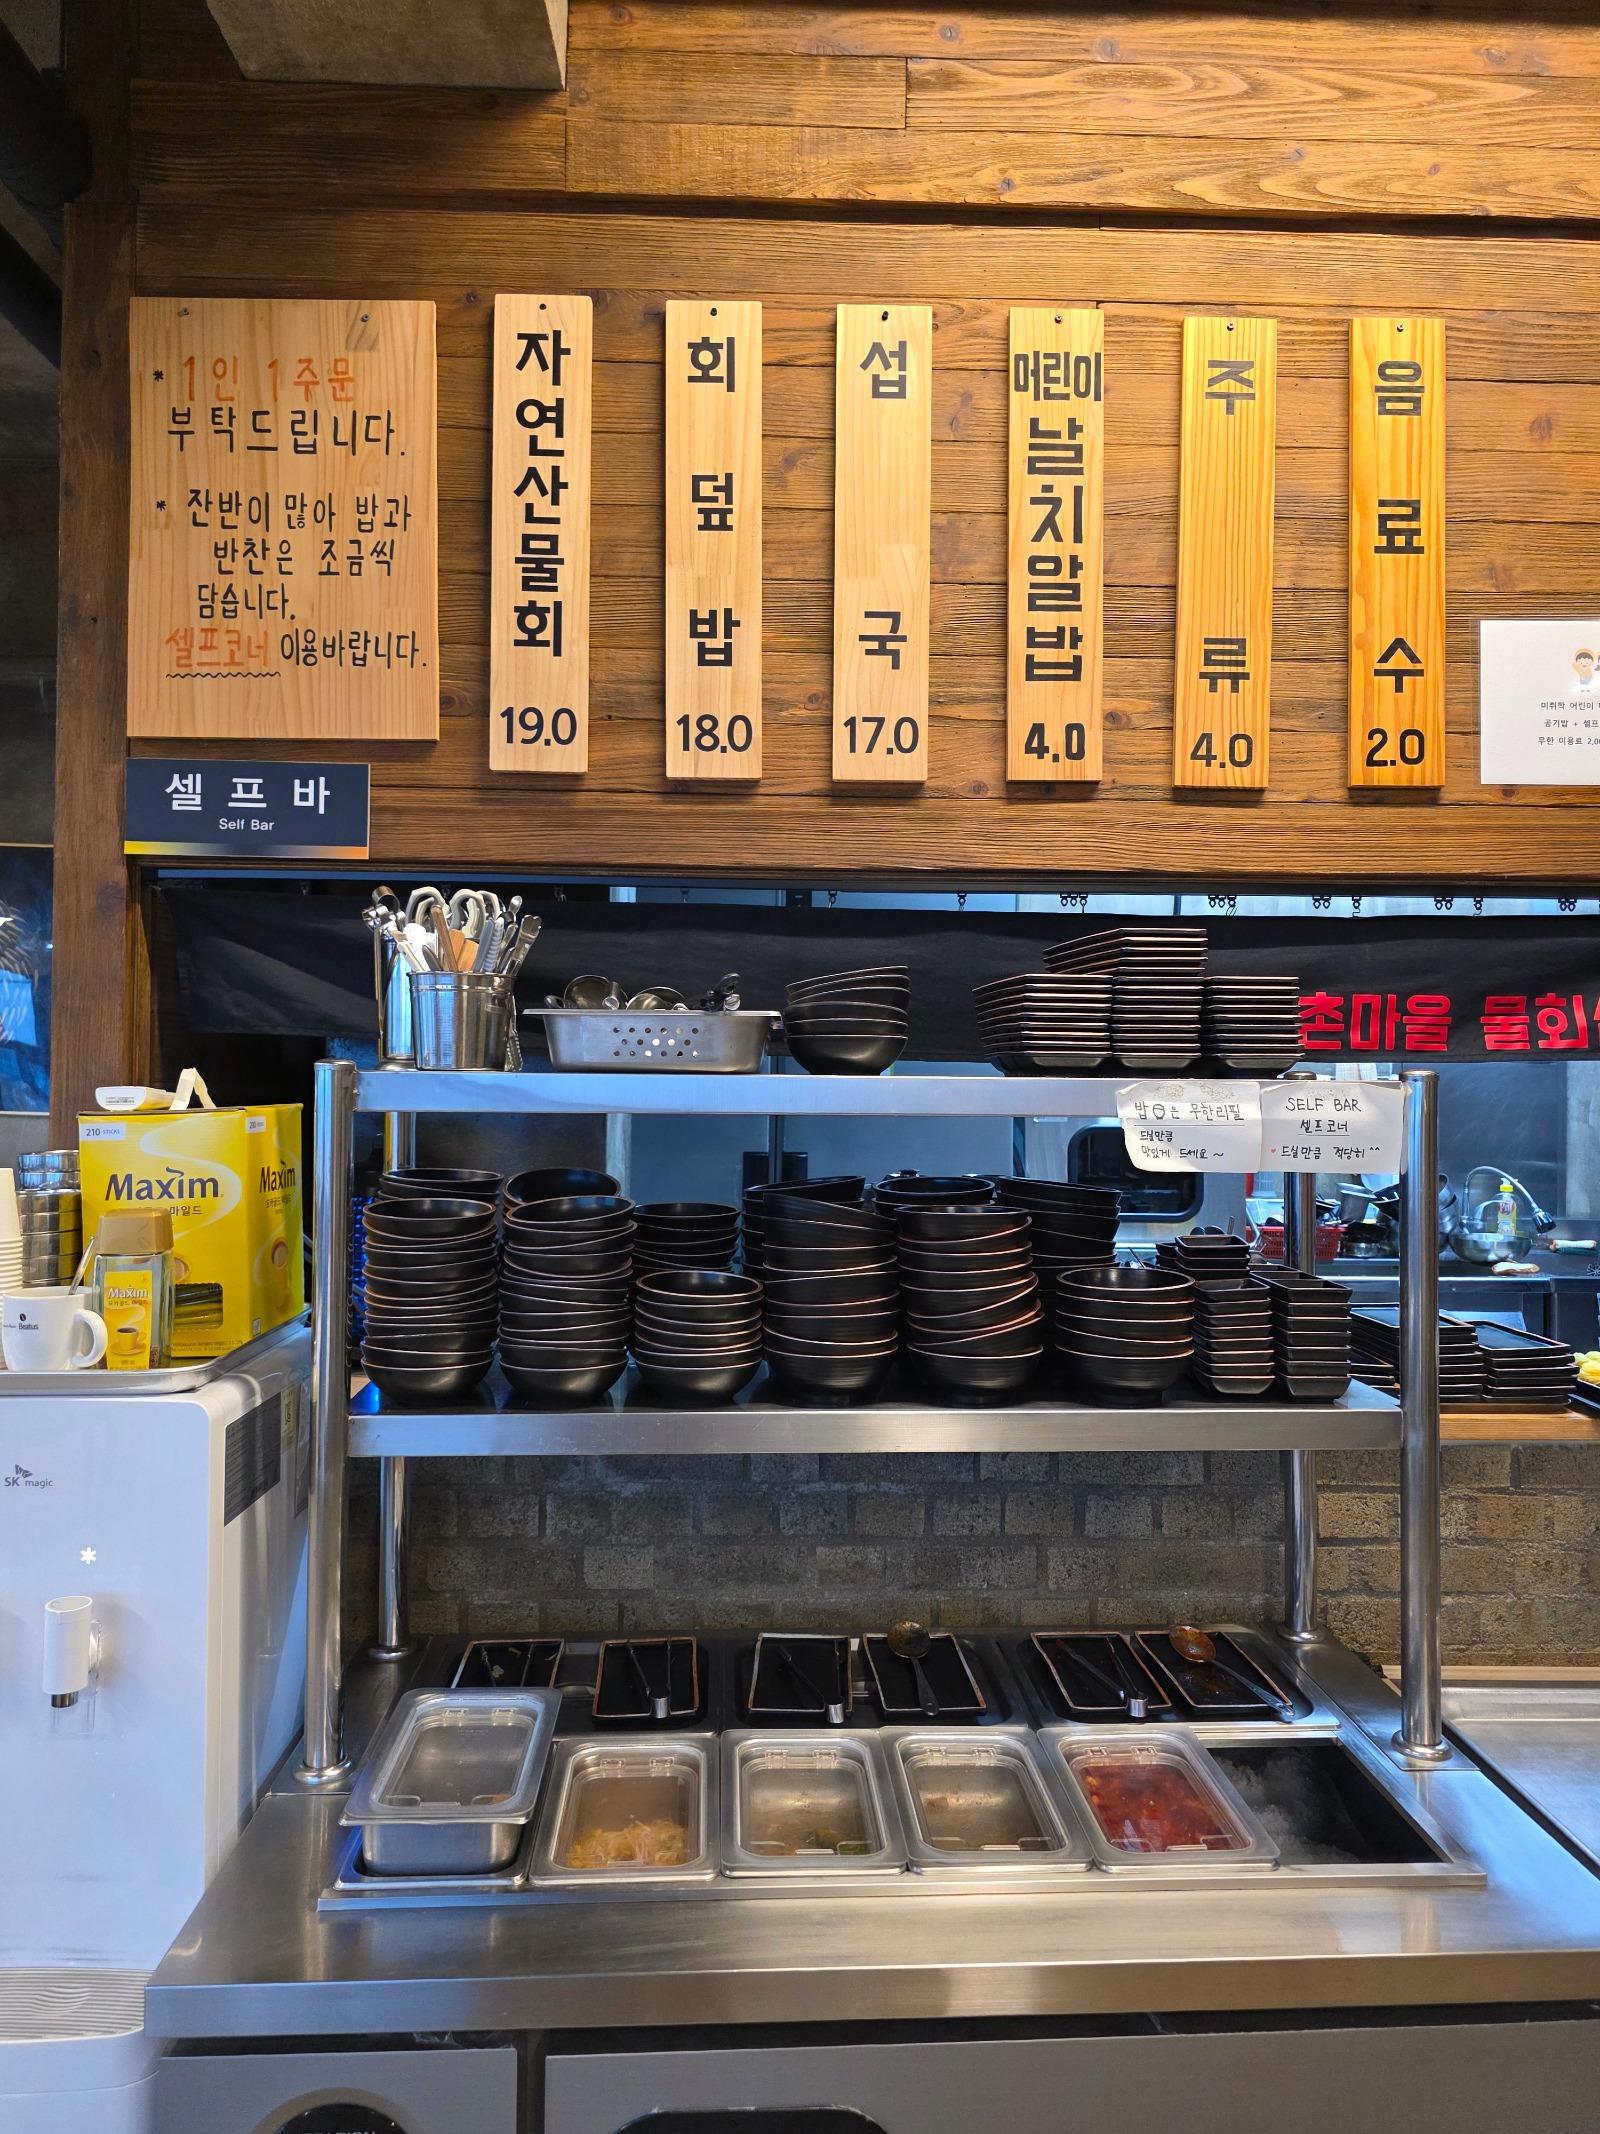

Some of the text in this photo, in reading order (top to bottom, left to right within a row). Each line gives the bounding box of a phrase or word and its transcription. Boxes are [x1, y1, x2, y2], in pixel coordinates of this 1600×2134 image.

[183, 356, 355, 402] 1인 1주문
[1013, 351, 1102, 402] 어린이
[168, 406, 407, 456] 부탁드립니다.
[187, 489, 411, 533] 잔반이 많아 밥과
[513, 329, 571, 657] 자연산물회
[213, 539, 395, 577] 반찬은 조금씩
[1025, 417, 1084, 682] 날치알밥
[198, 583, 296, 620] 담습니다.
[165, 628, 428, 669] 셀프코너 이용바랍니다.
[1569, 701, 1594, 710] 어린이
[499, 706, 578, 747] 19.0
[676, 713, 753, 754] 18.0
[843, 716, 920, 755] 17.0
[1024, 722, 1086, 763] 4.0
[1538, 736, 1554, 746] 무한
[1190, 733, 1254, 769] 4.0
[1365, 728, 1426, 768] 2.0
[218, 818, 275, 831] Self Bar
[1480, 992, 1600, 1051] 물회
[1134, 1101, 1149, 1120] 밥
[1190, 1102, 1245, 1121] 무한리필
[1285, 1097, 1362, 1112] SELF BAR
[86, 1128, 101, 1136] 210
[1281, 1146, 1322, 1160] 드실만큼
[104, 1166, 219, 1201] Maxim
[259, 1160, 296, 1194] Maxim
[169, 1205, 203, 1217] 마일드
[107, 1284, 149, 1299] Maxim
[4, 1476, 53, 1489] SK magic
